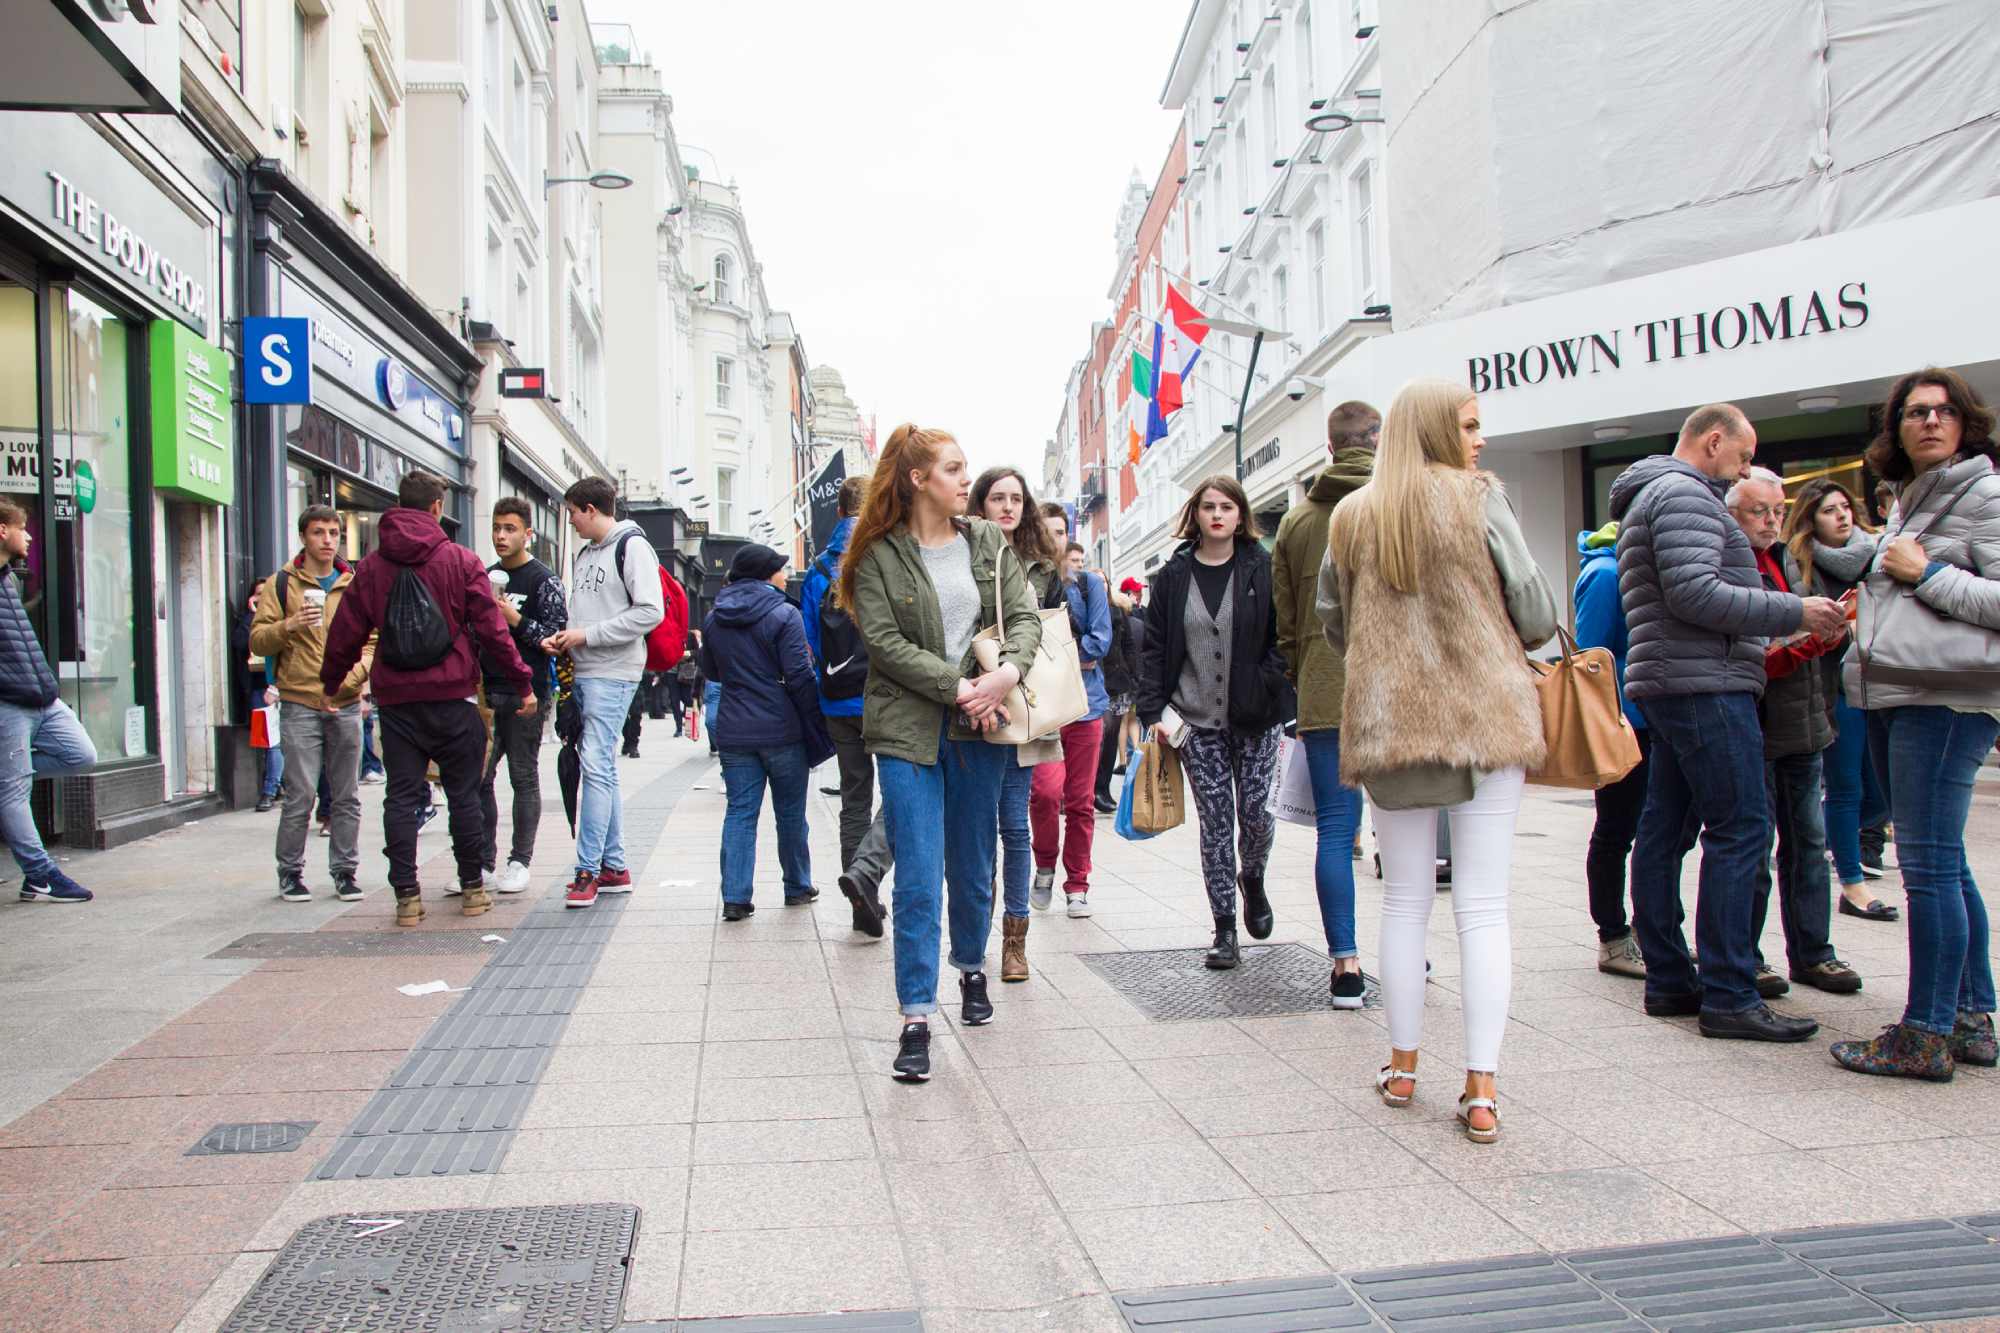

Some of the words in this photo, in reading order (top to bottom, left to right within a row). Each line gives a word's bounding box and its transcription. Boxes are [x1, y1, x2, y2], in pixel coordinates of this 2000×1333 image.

[46, 169, 99, 244] THE
[103, 208, 159, 286] BODY
[1467, 329, 1622, 394] BROWN
[1634, 281, 1870, 363] THOMAS
[810, 477, 842, 502] M&S
[686, 522, 706, 533] M&S
